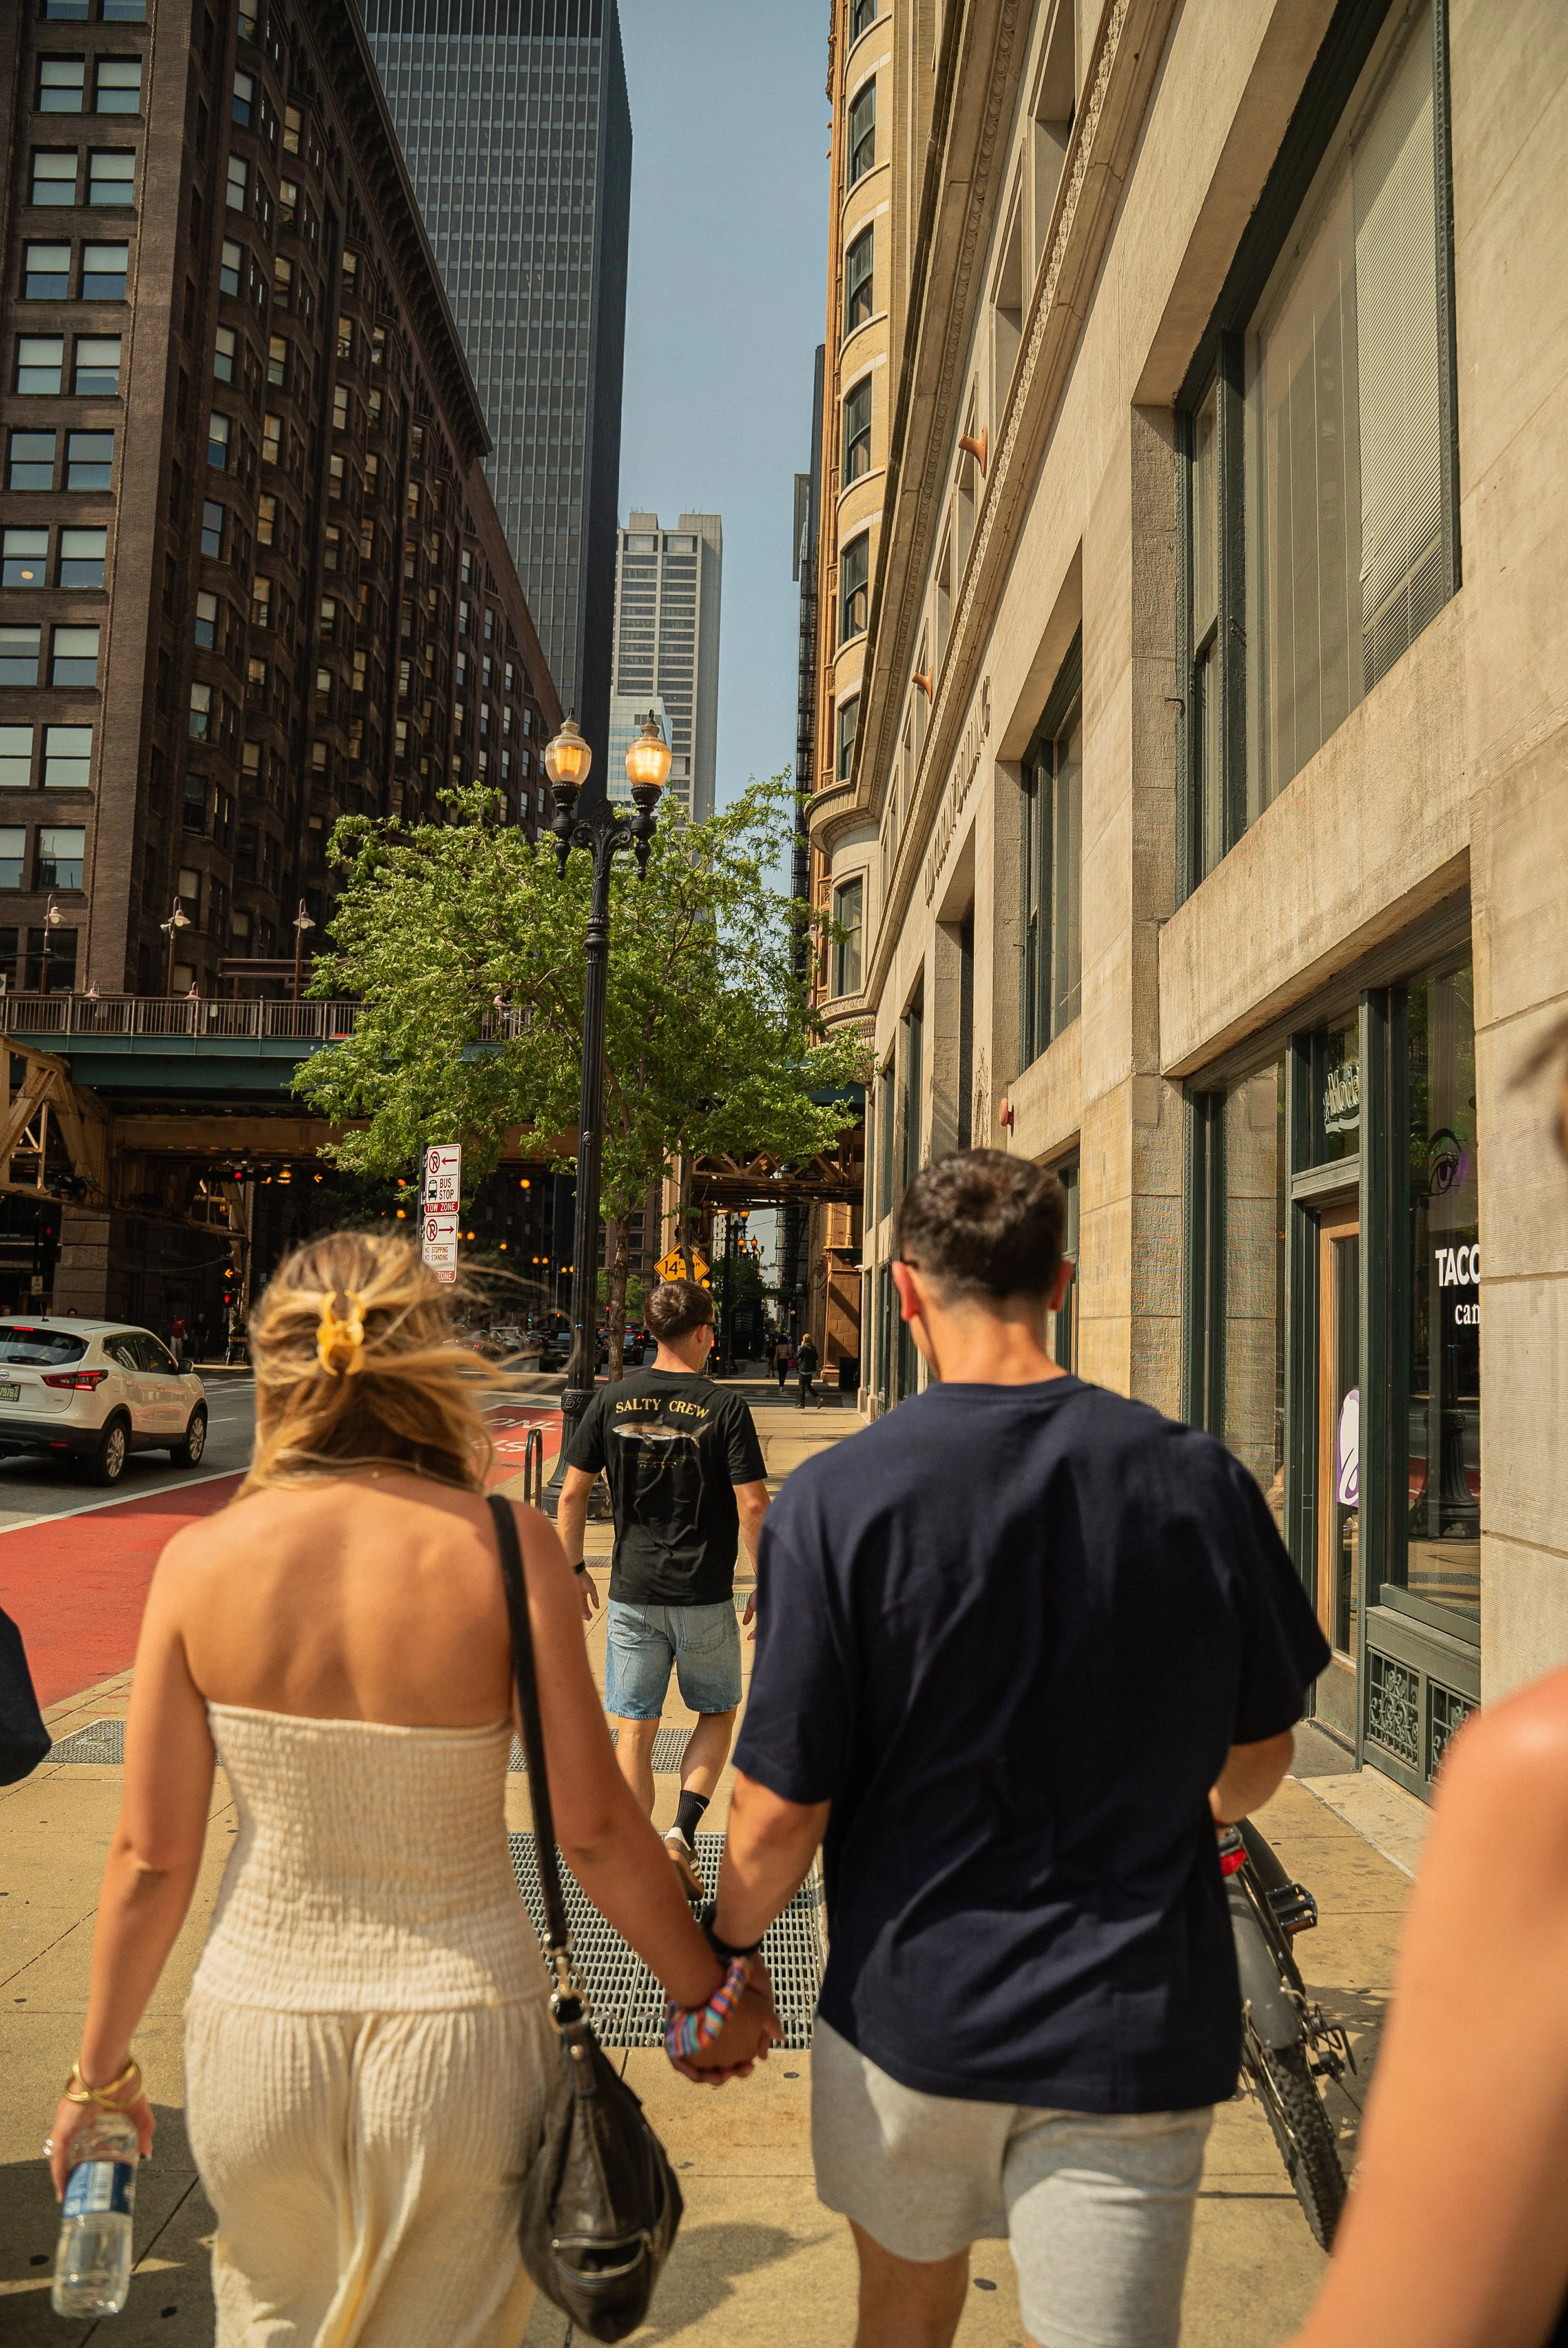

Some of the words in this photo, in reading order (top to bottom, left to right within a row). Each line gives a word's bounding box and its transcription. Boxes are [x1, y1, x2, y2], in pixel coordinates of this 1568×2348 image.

[440, 1177, 452, 1188] BUS
[439, 1189, 454, 1200] STOP
[426, 1203, 438, 1212] TOW
[440, 1202, 456, 1211] ZONE
[664, 1260, 701, 1275] 14'-"
[437, 1272, 452, 1280] ZONE
[616, 1398, 662, 1414] SALTY
[669, 1400, 710, 1419] CREW
